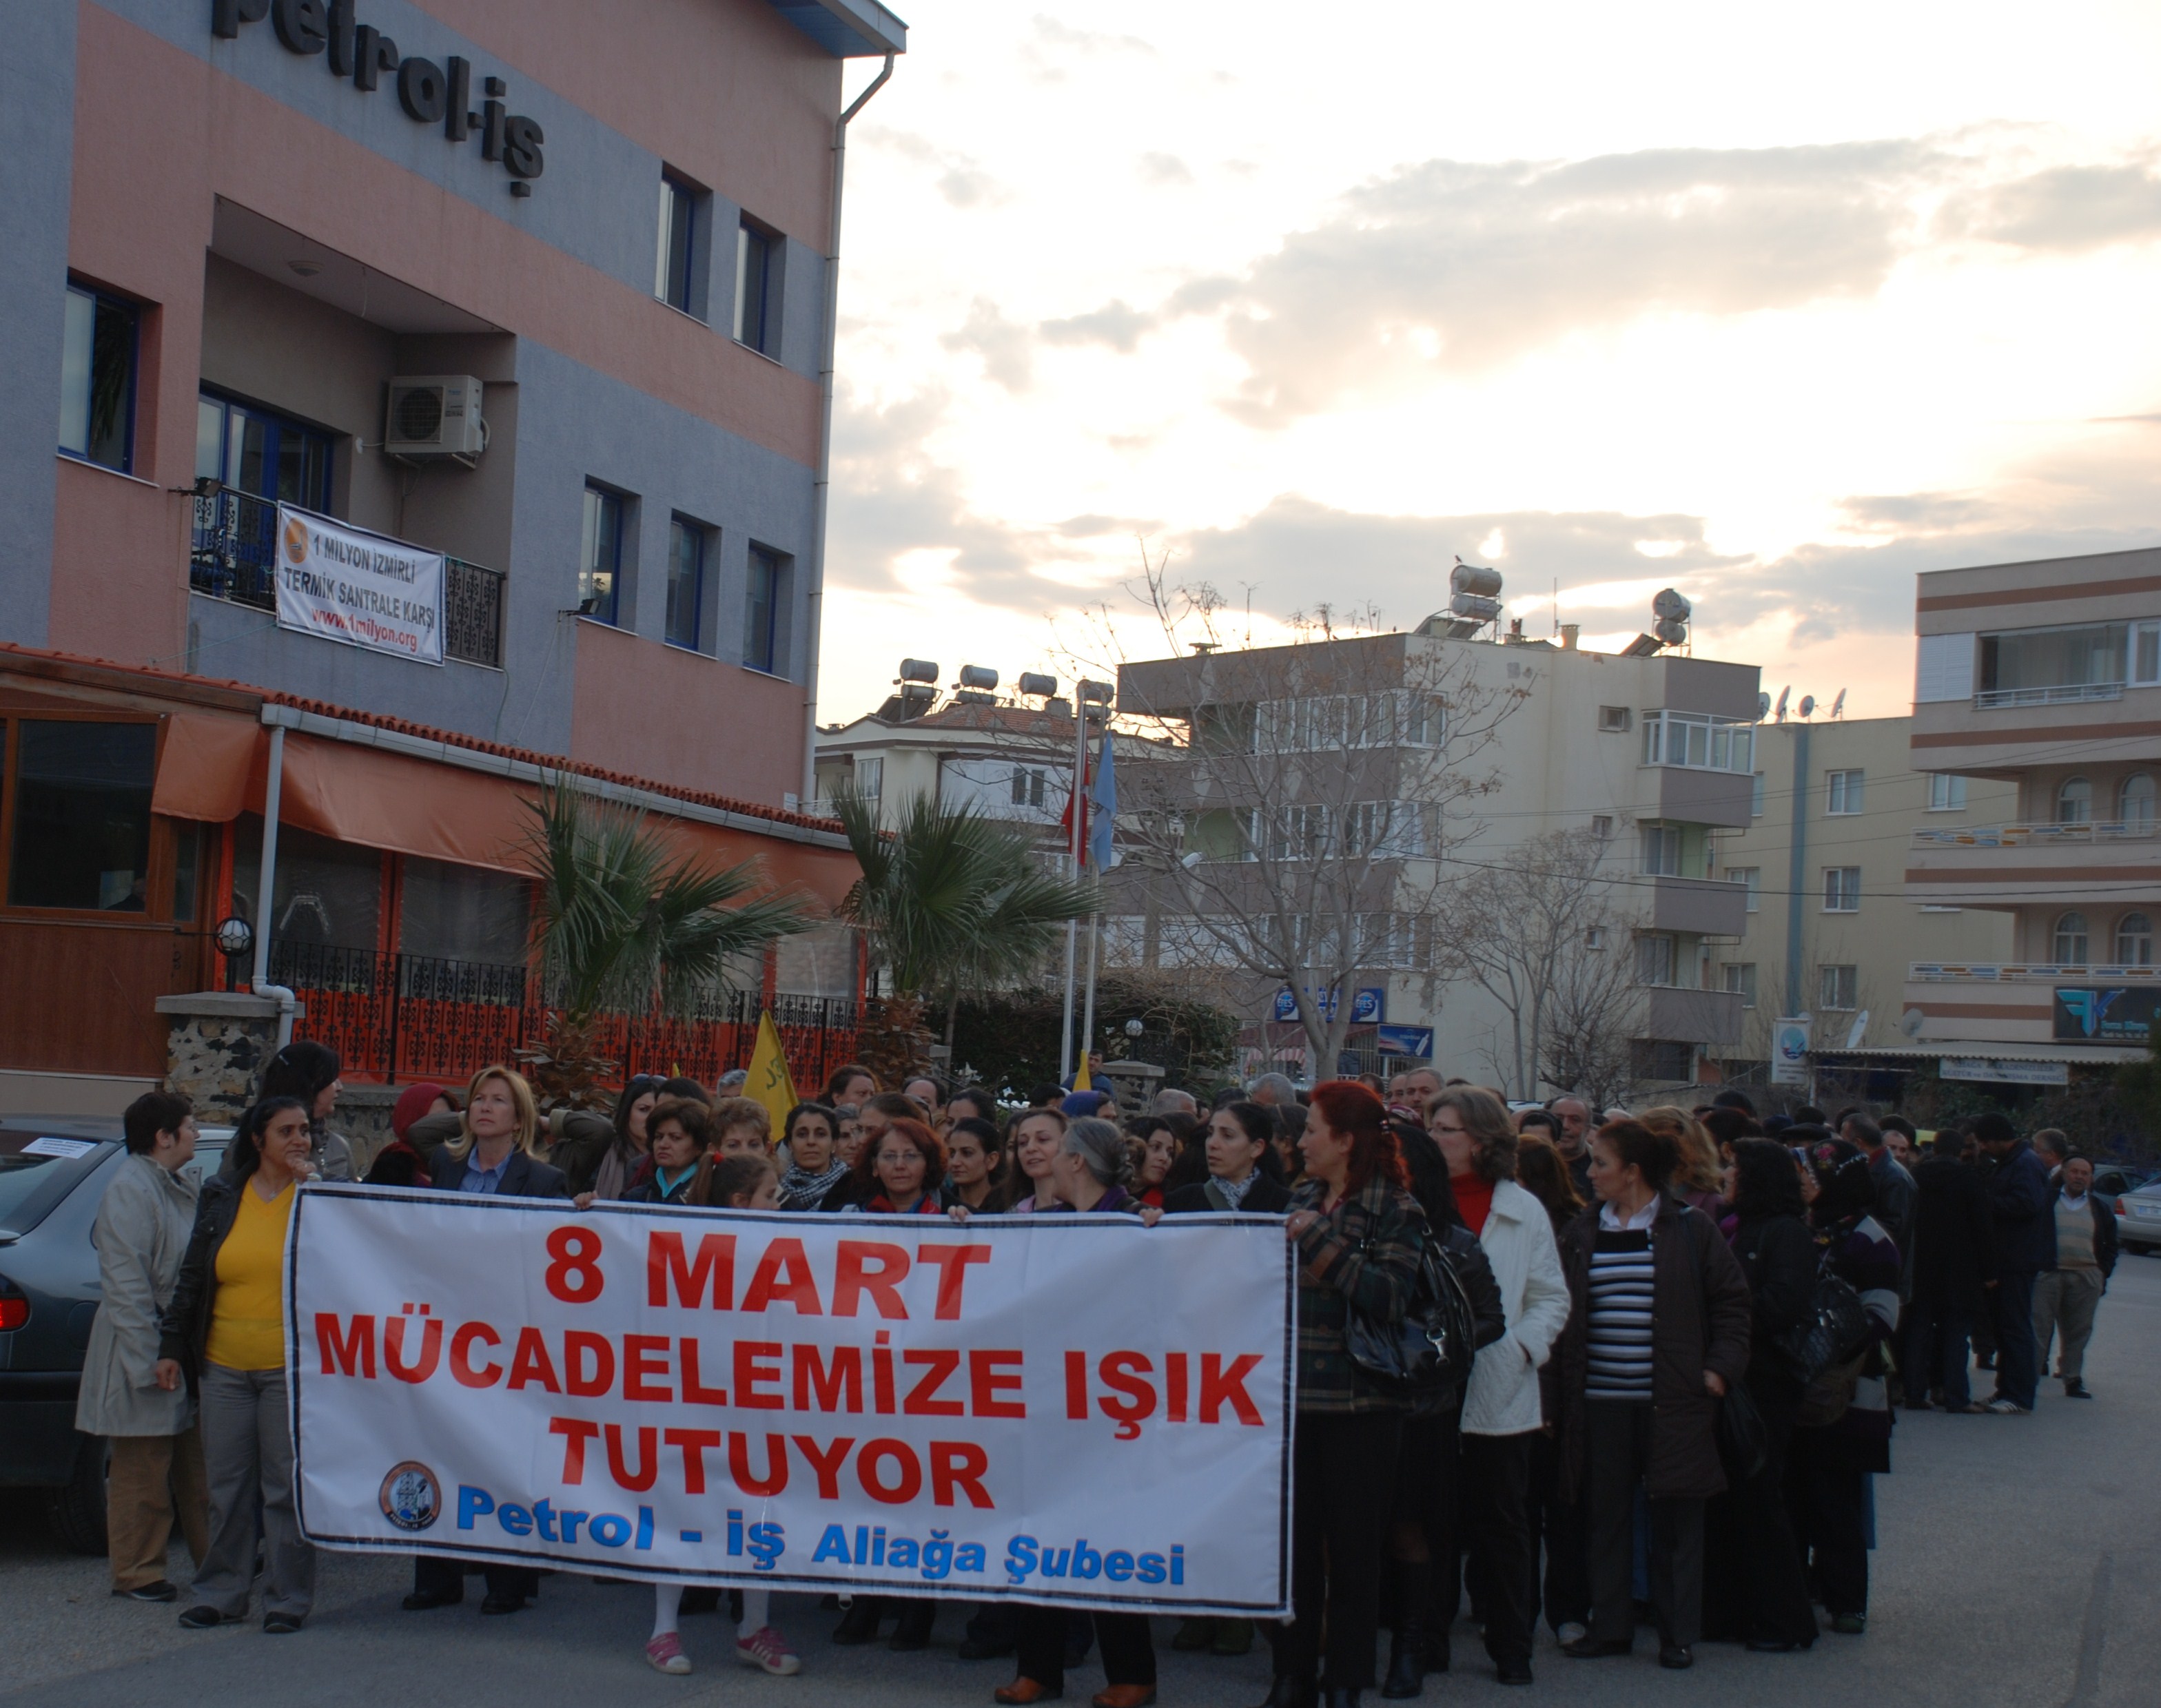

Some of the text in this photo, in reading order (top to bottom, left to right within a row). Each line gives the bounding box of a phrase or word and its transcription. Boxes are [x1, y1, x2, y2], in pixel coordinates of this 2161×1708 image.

[314, 534, 416, 584] 1 MİLYON İZMİRLİ
[284, 566, 436, 633] TERMİK SANTRALE KARŞI
[311, 608, 418, 652] www.1milyon.org
[1277, 997, 1293, 1007] EFES
[1355, 999, 1373, 1009] EFES
[545, 1226, 992, 1321] 8 MART
[314, 1302, 1265, 1440] MÜCADELEMİZE IŞIK
[549, 1417, 996, 1510] TUTUYOR
[456, 1484, 656, 1551] Petrol
[726, 1509, 786, 1570] iş
[811, 1523, 987, 1579] Aliağa
[1004, 1534, 1185, 1585] Şubesi
